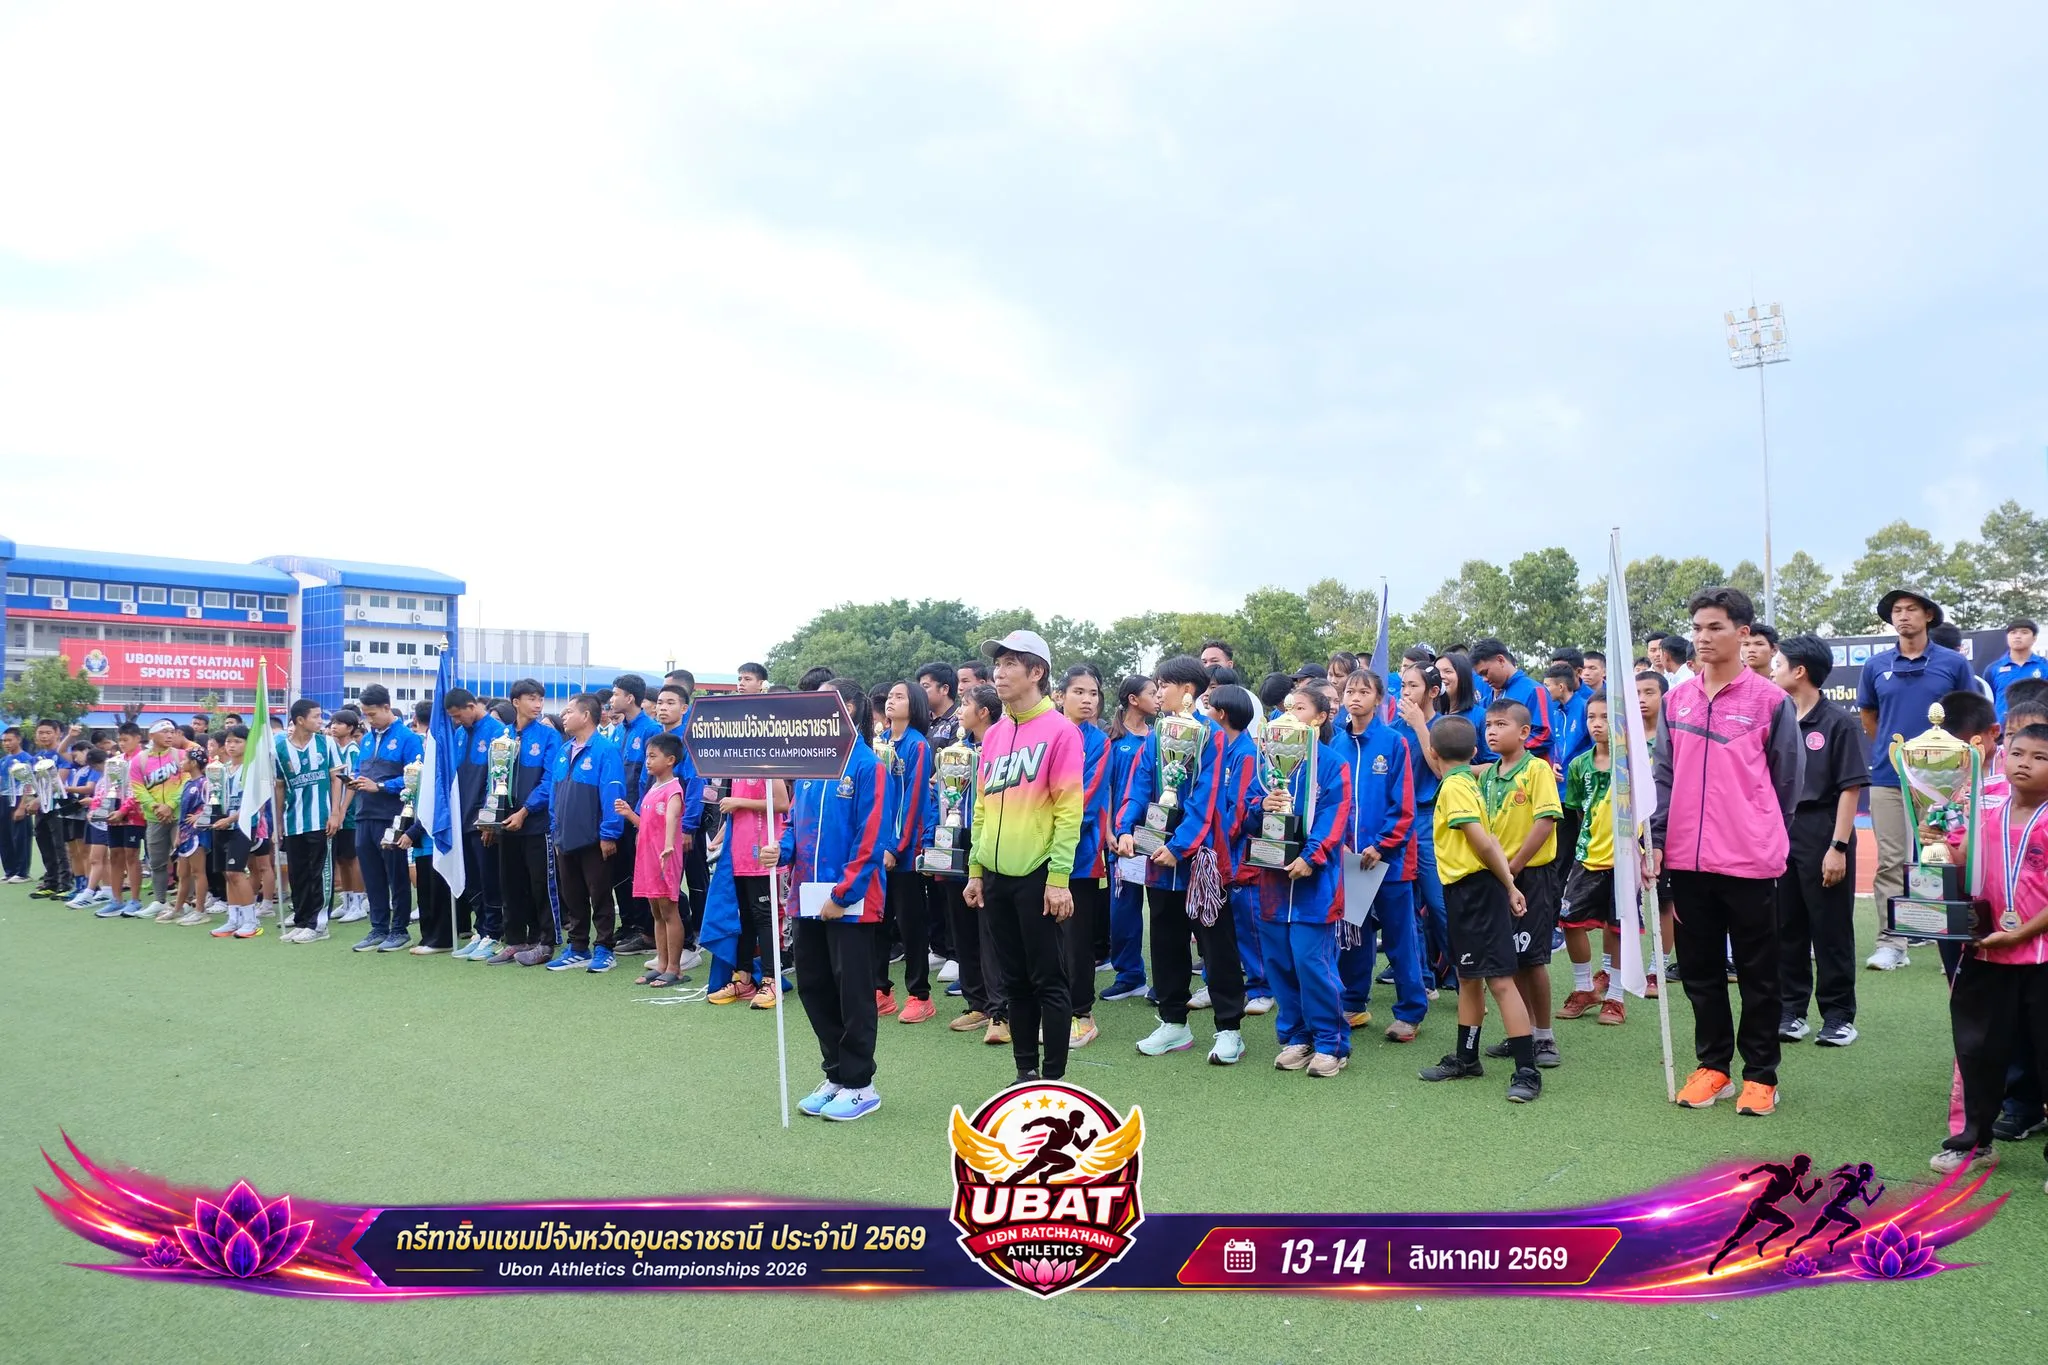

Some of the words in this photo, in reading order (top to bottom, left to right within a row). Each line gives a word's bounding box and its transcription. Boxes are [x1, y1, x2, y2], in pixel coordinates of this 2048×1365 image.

[124, 652, 254, 668] UBONRATCHATHANI
[140, 667, 190, 679] SPORTS
[196, 669, 245, 681] SCHOOL
[698, 748, 721, 758] UBON
[722, 748, 767, 758] ATHLETICS
[769, 747, 837, 758] CHAMPIONSHIPS
[1512, 931, 1532, 953] 19
